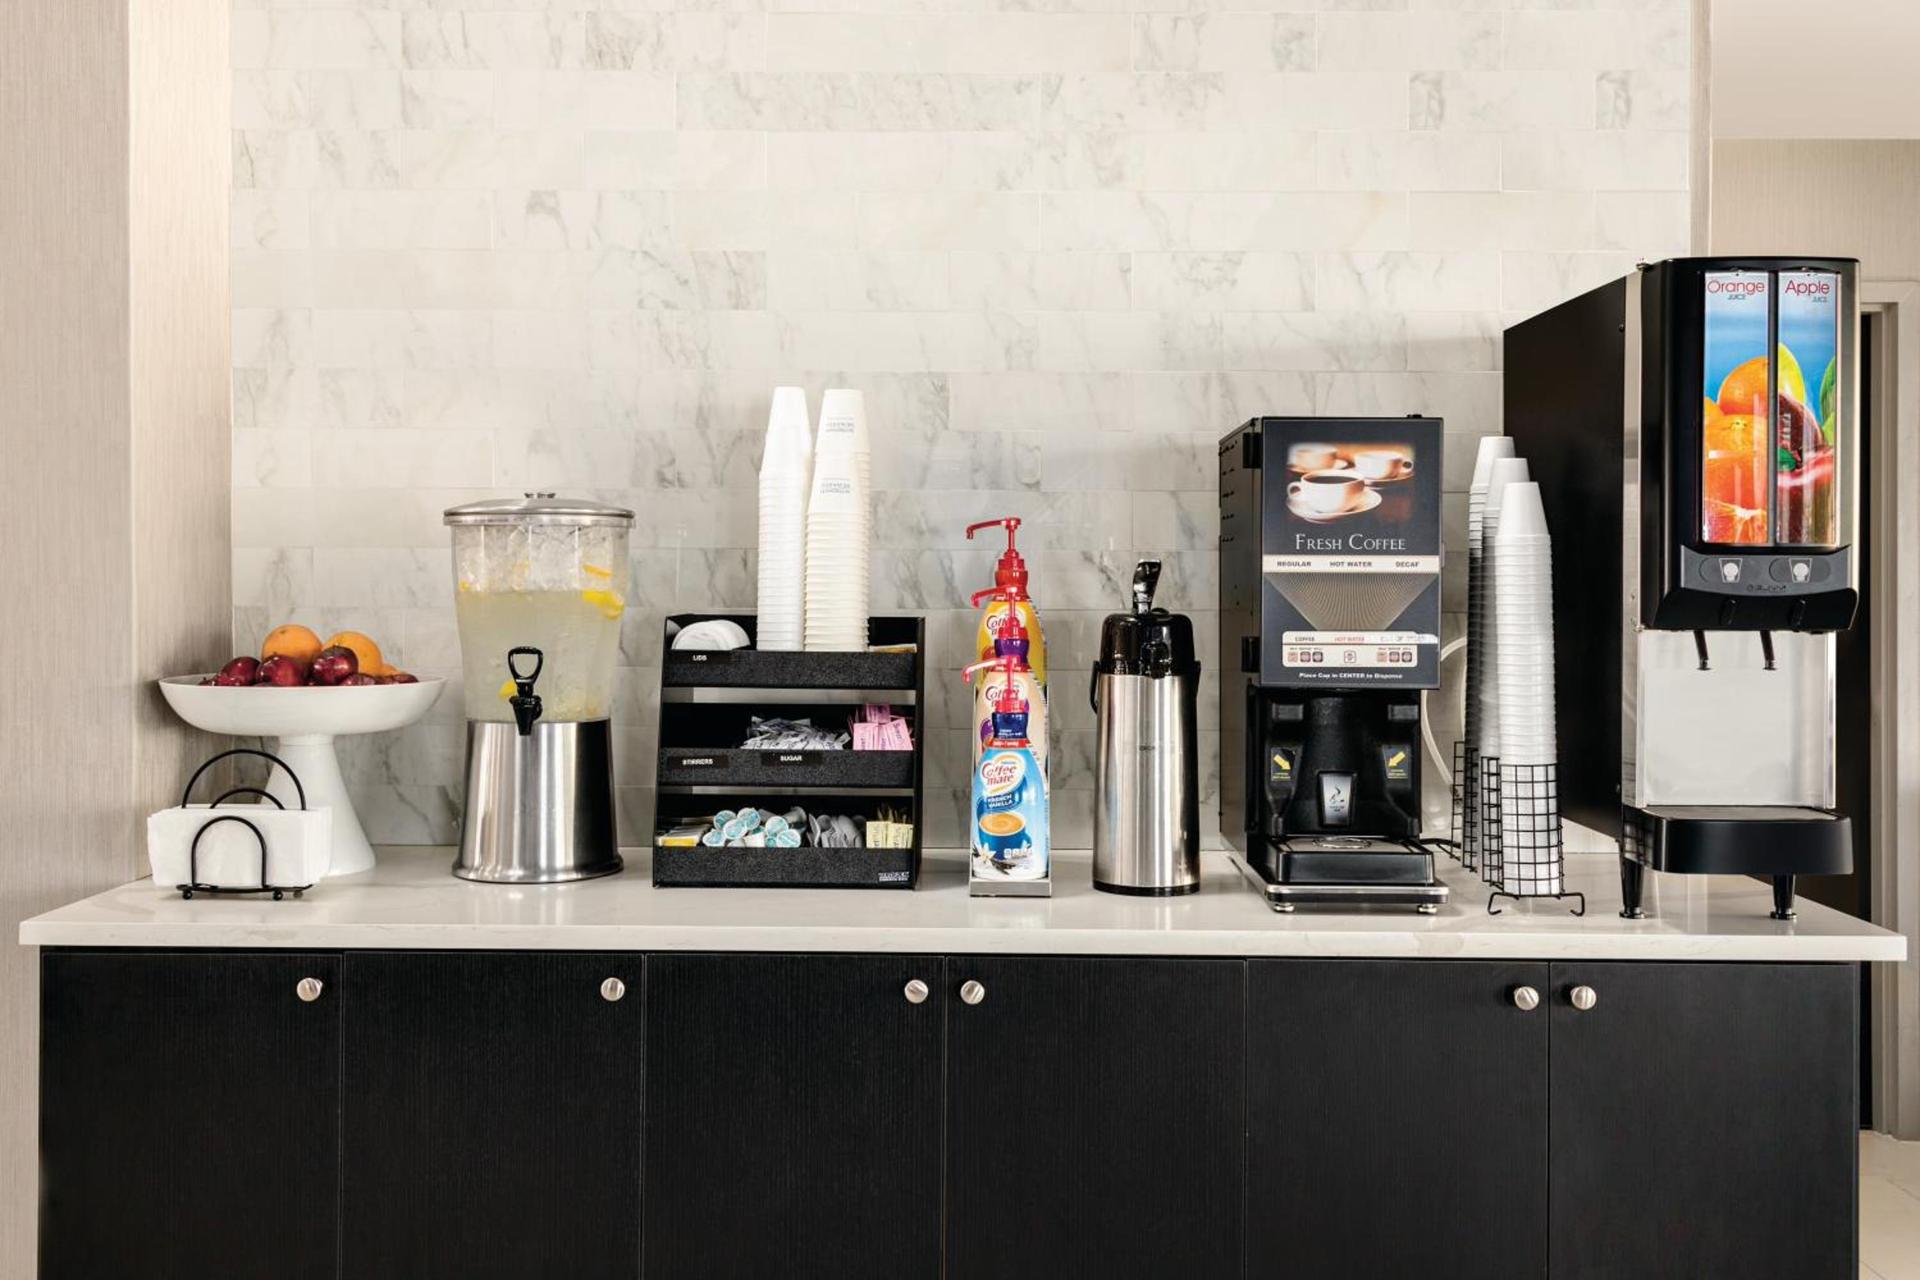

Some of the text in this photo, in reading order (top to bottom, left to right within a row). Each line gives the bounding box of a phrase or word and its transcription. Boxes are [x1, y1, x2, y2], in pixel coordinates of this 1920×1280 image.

[1707, 280, 1765, 296] Orange
[1785, 279, 1830, 296] Apple
[1318, 672, 1330, 680] Cup
[982, 761, 1017, 779] Coffee
[987, 774, 1014, 786] mate
